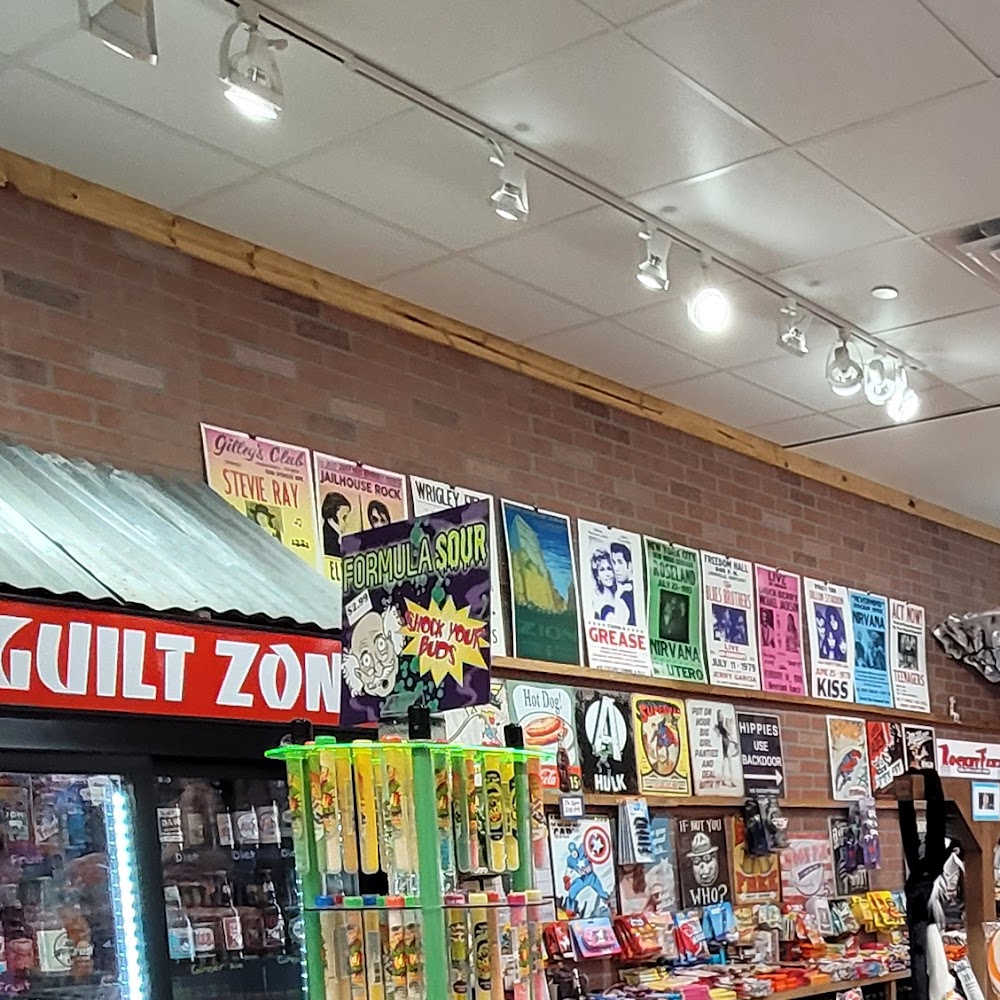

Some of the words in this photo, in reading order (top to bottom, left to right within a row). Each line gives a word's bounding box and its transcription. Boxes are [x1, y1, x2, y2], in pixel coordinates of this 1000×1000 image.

[214, 435, 263, 462] Gilly's
[270, 446, 306, 466] Club
[222, 468, 267, 503] STEVIE
[272, 479, 299, 509] RAY
[319, 470, 372, 493] JAILHOUSE
[374, 484, 401, 500] ROCK
[343, 537, 432, 591] FORMULA
[436, 523, 488, 573] SOUR
[768, 572, 787, 586] LIVE
[405, 609, 444, 637] SHOCK
[449, 624, 487, 648] YOUR
[852, 611, 886, 629] NIRVANA
[588, 626, 646, 650] GREASE
[419, 638, 457, 667] BUDS
[650, 639, 700, 663] NIRVANA
[0, 613, 195, 702] GUILT
[214, 637, 341, 713] ZON
[667, 663, 704, 681] UTERO
[712, 658, 727, 668] JULY
[816, 678, 849, 699] KISS
[523, 688, 541, 708] Hot
[541, 692, 564, 714] Dog!
[739, 721, 779, 736] HIPPIES
[753, 740, 769, 752] USE
[742, 754, 783, 767] BACKDOOR
[594, 773, 628, 793] HULK
[678, 821, 688, 833] IF
[690, 820, 706, 832] NOT
[707, 819, 723, 832] YOU
[689, 885, 728, 905] WHO?
